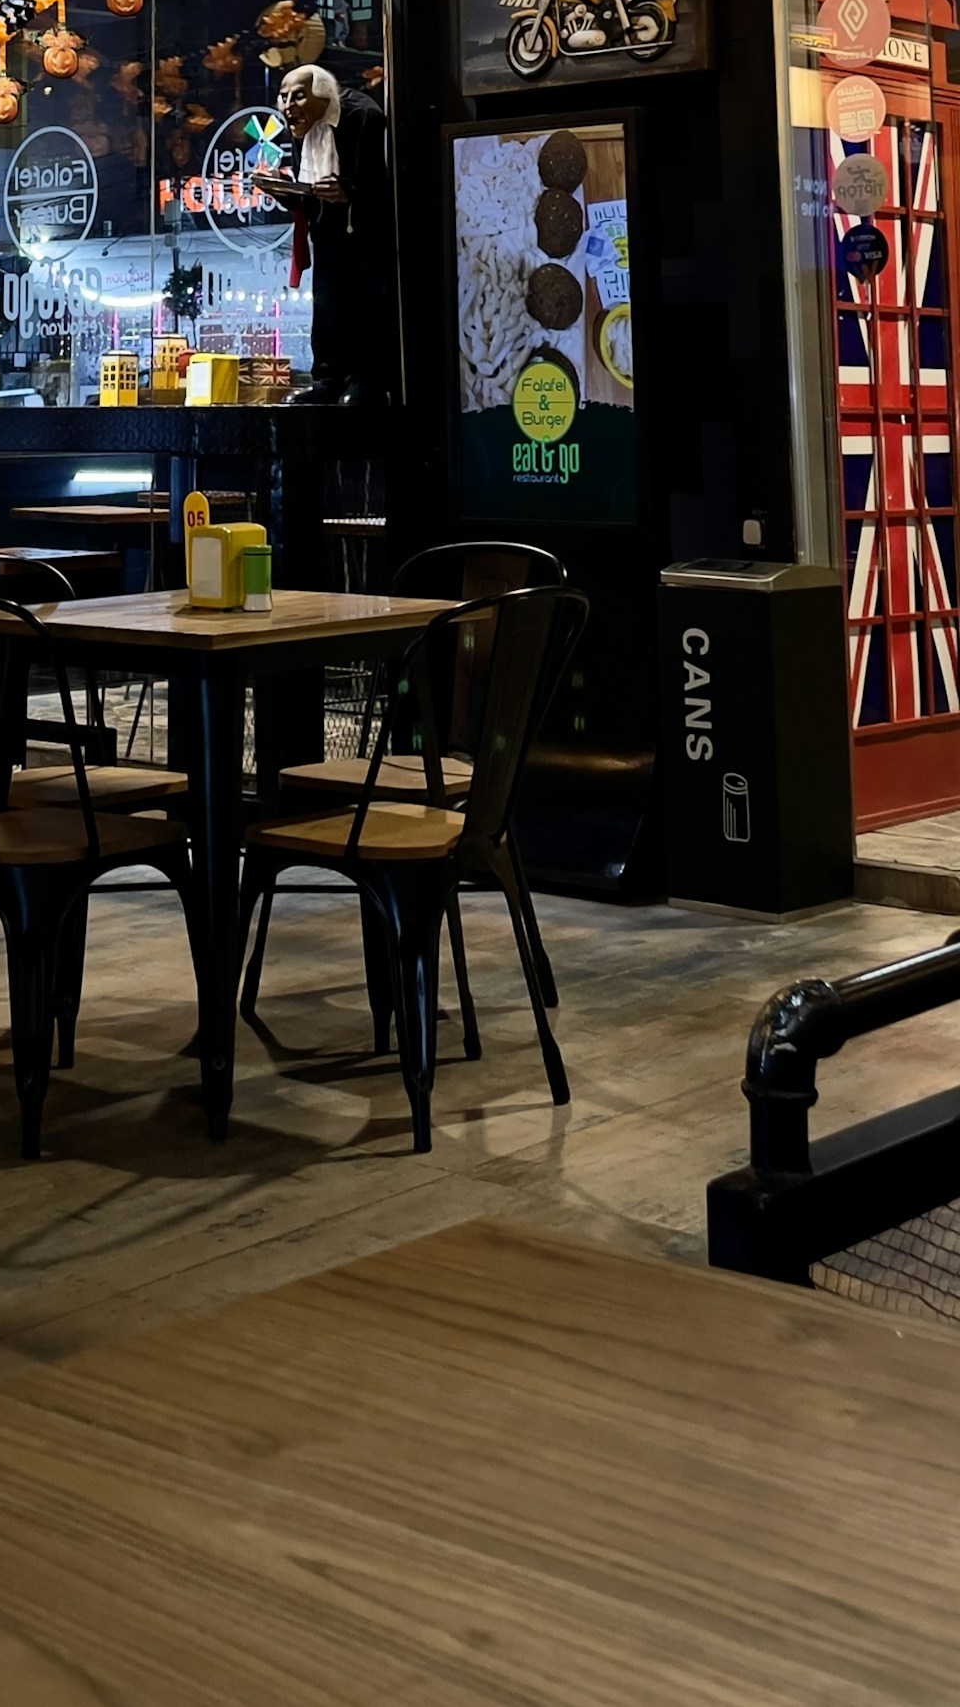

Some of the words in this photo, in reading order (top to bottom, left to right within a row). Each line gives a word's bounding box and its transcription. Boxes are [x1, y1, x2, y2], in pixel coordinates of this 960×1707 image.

[521, 377, 567, 392] Falafel
[538, 394, 550, 411] &
[521, 411, 567, 429] Burger
[512, 473, 560, 484] restaurant
[187, 510, 205, 527] 05
[682, 627, 713, 761] CANS
